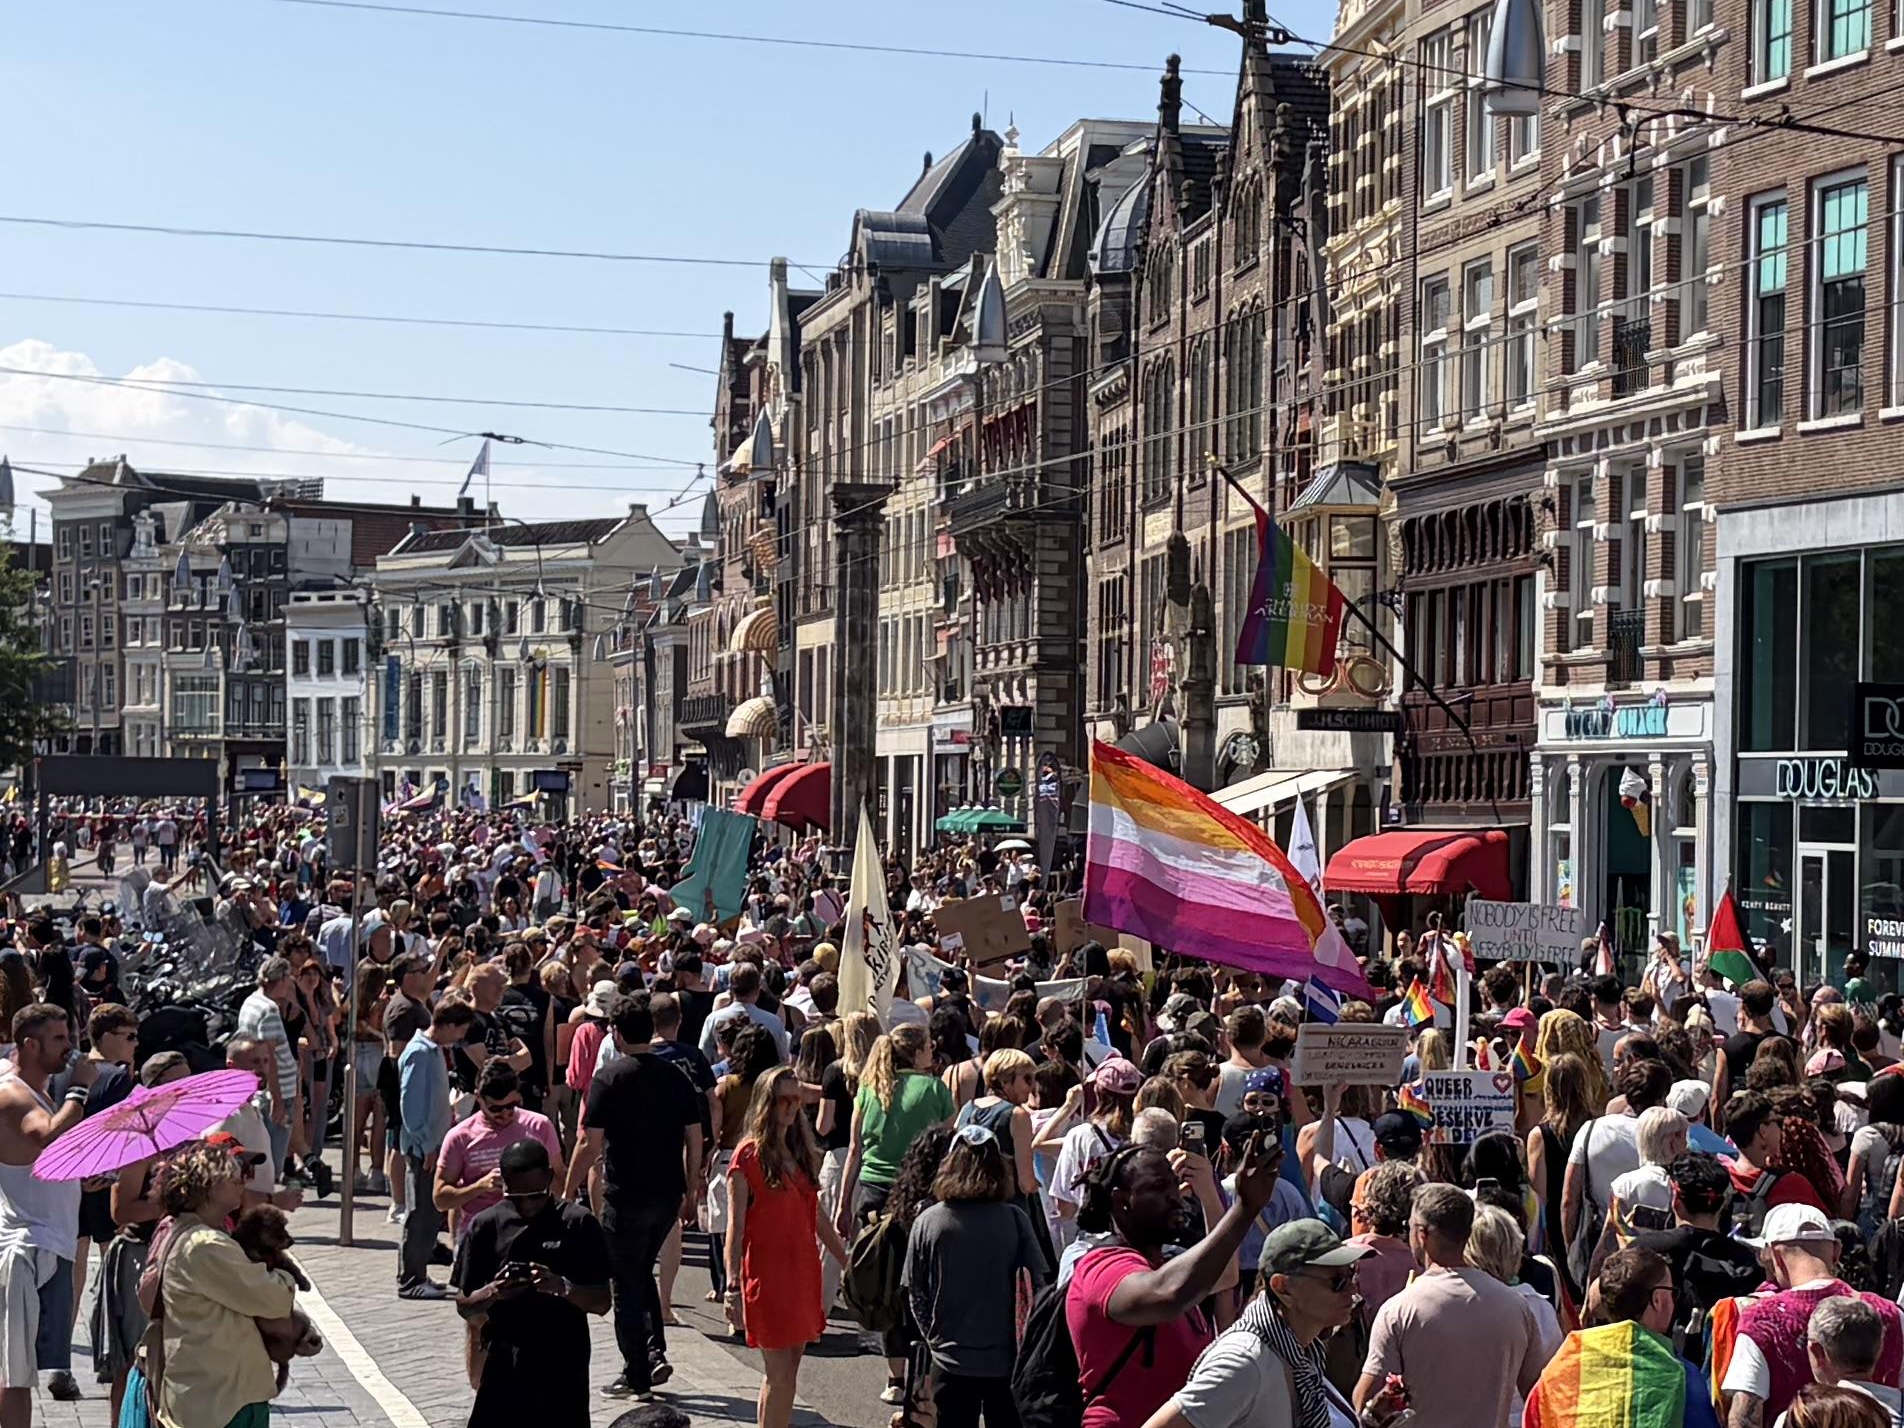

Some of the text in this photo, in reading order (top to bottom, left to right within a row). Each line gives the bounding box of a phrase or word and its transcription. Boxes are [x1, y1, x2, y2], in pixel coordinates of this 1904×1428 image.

[1776, 759, 1873, 798] DOUGLAS
[1470, 903, 1527, 928] NOBODY
[1541, 905, 1578, 933] FREE
[1425, 1077, 1473, 1098] QUEER
